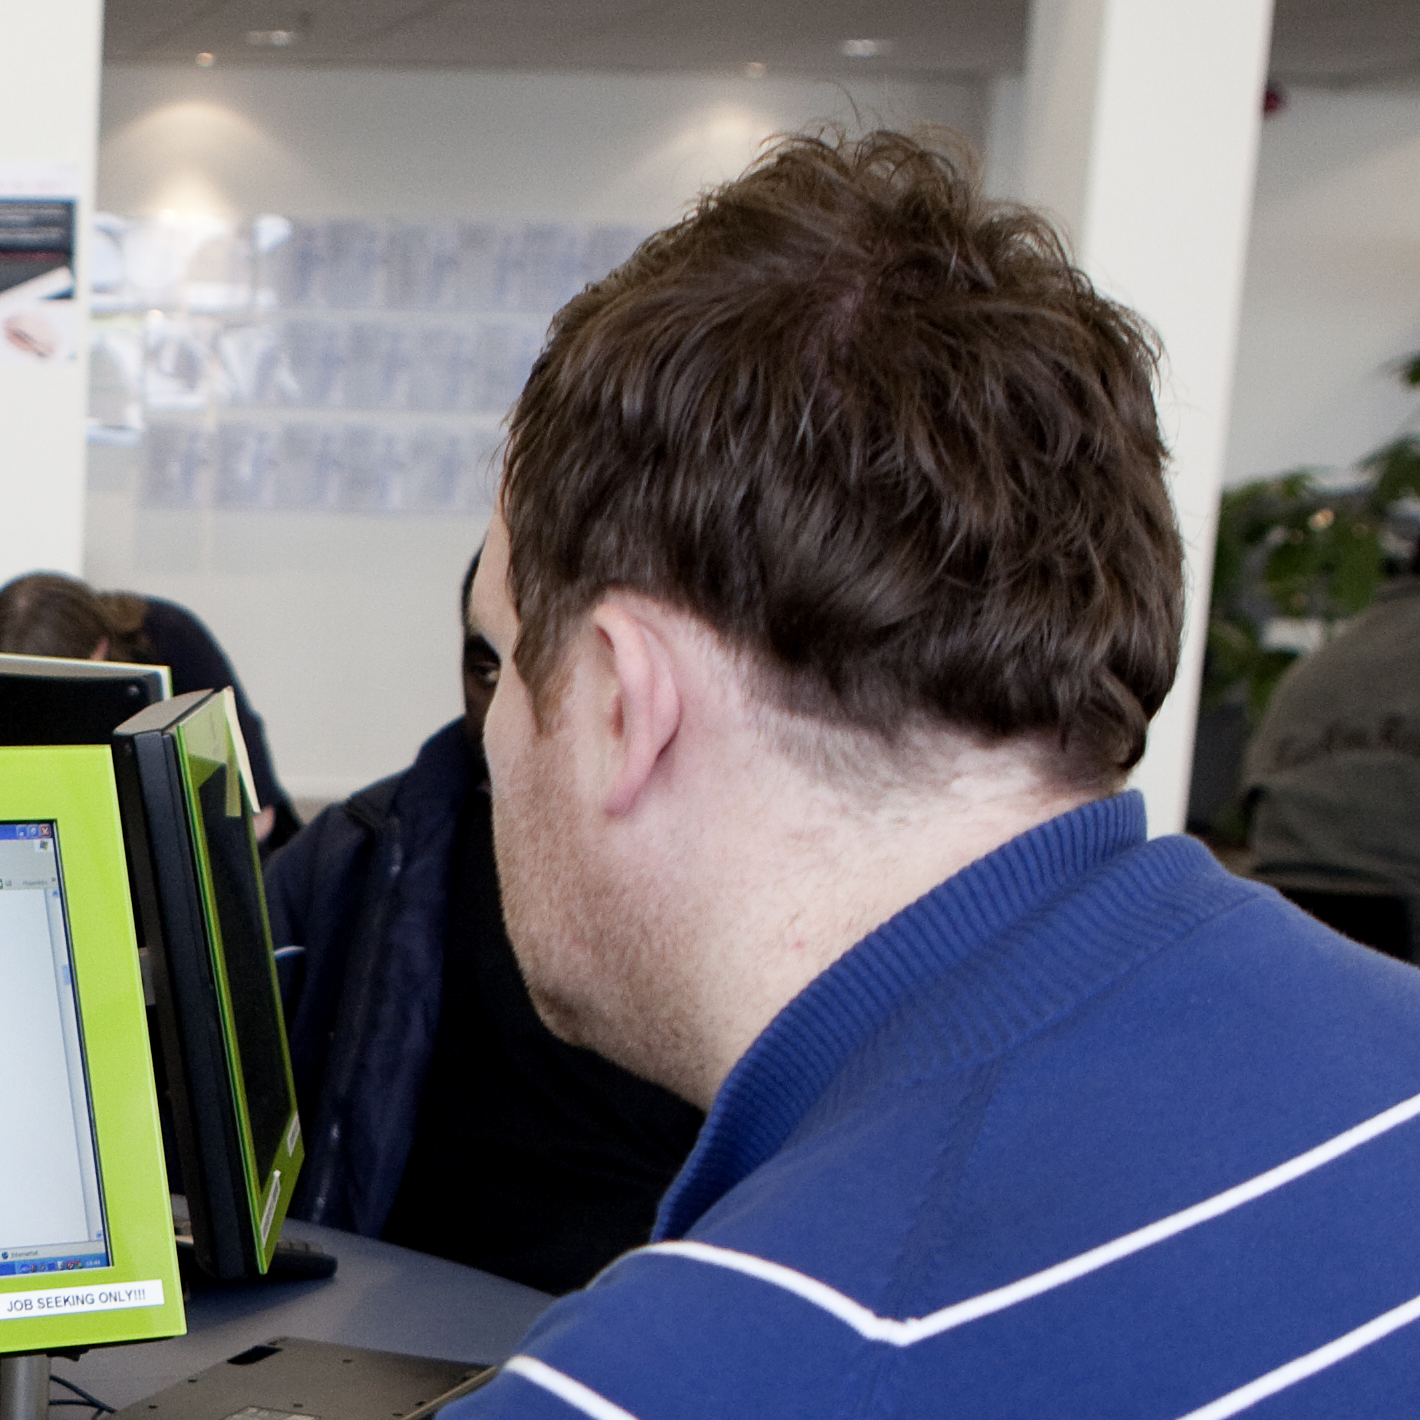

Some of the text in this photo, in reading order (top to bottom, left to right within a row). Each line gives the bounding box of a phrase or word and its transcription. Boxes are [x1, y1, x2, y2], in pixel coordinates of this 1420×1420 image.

[7, 1289, 146, 1313] JOB SEEKING ONLY!!!
